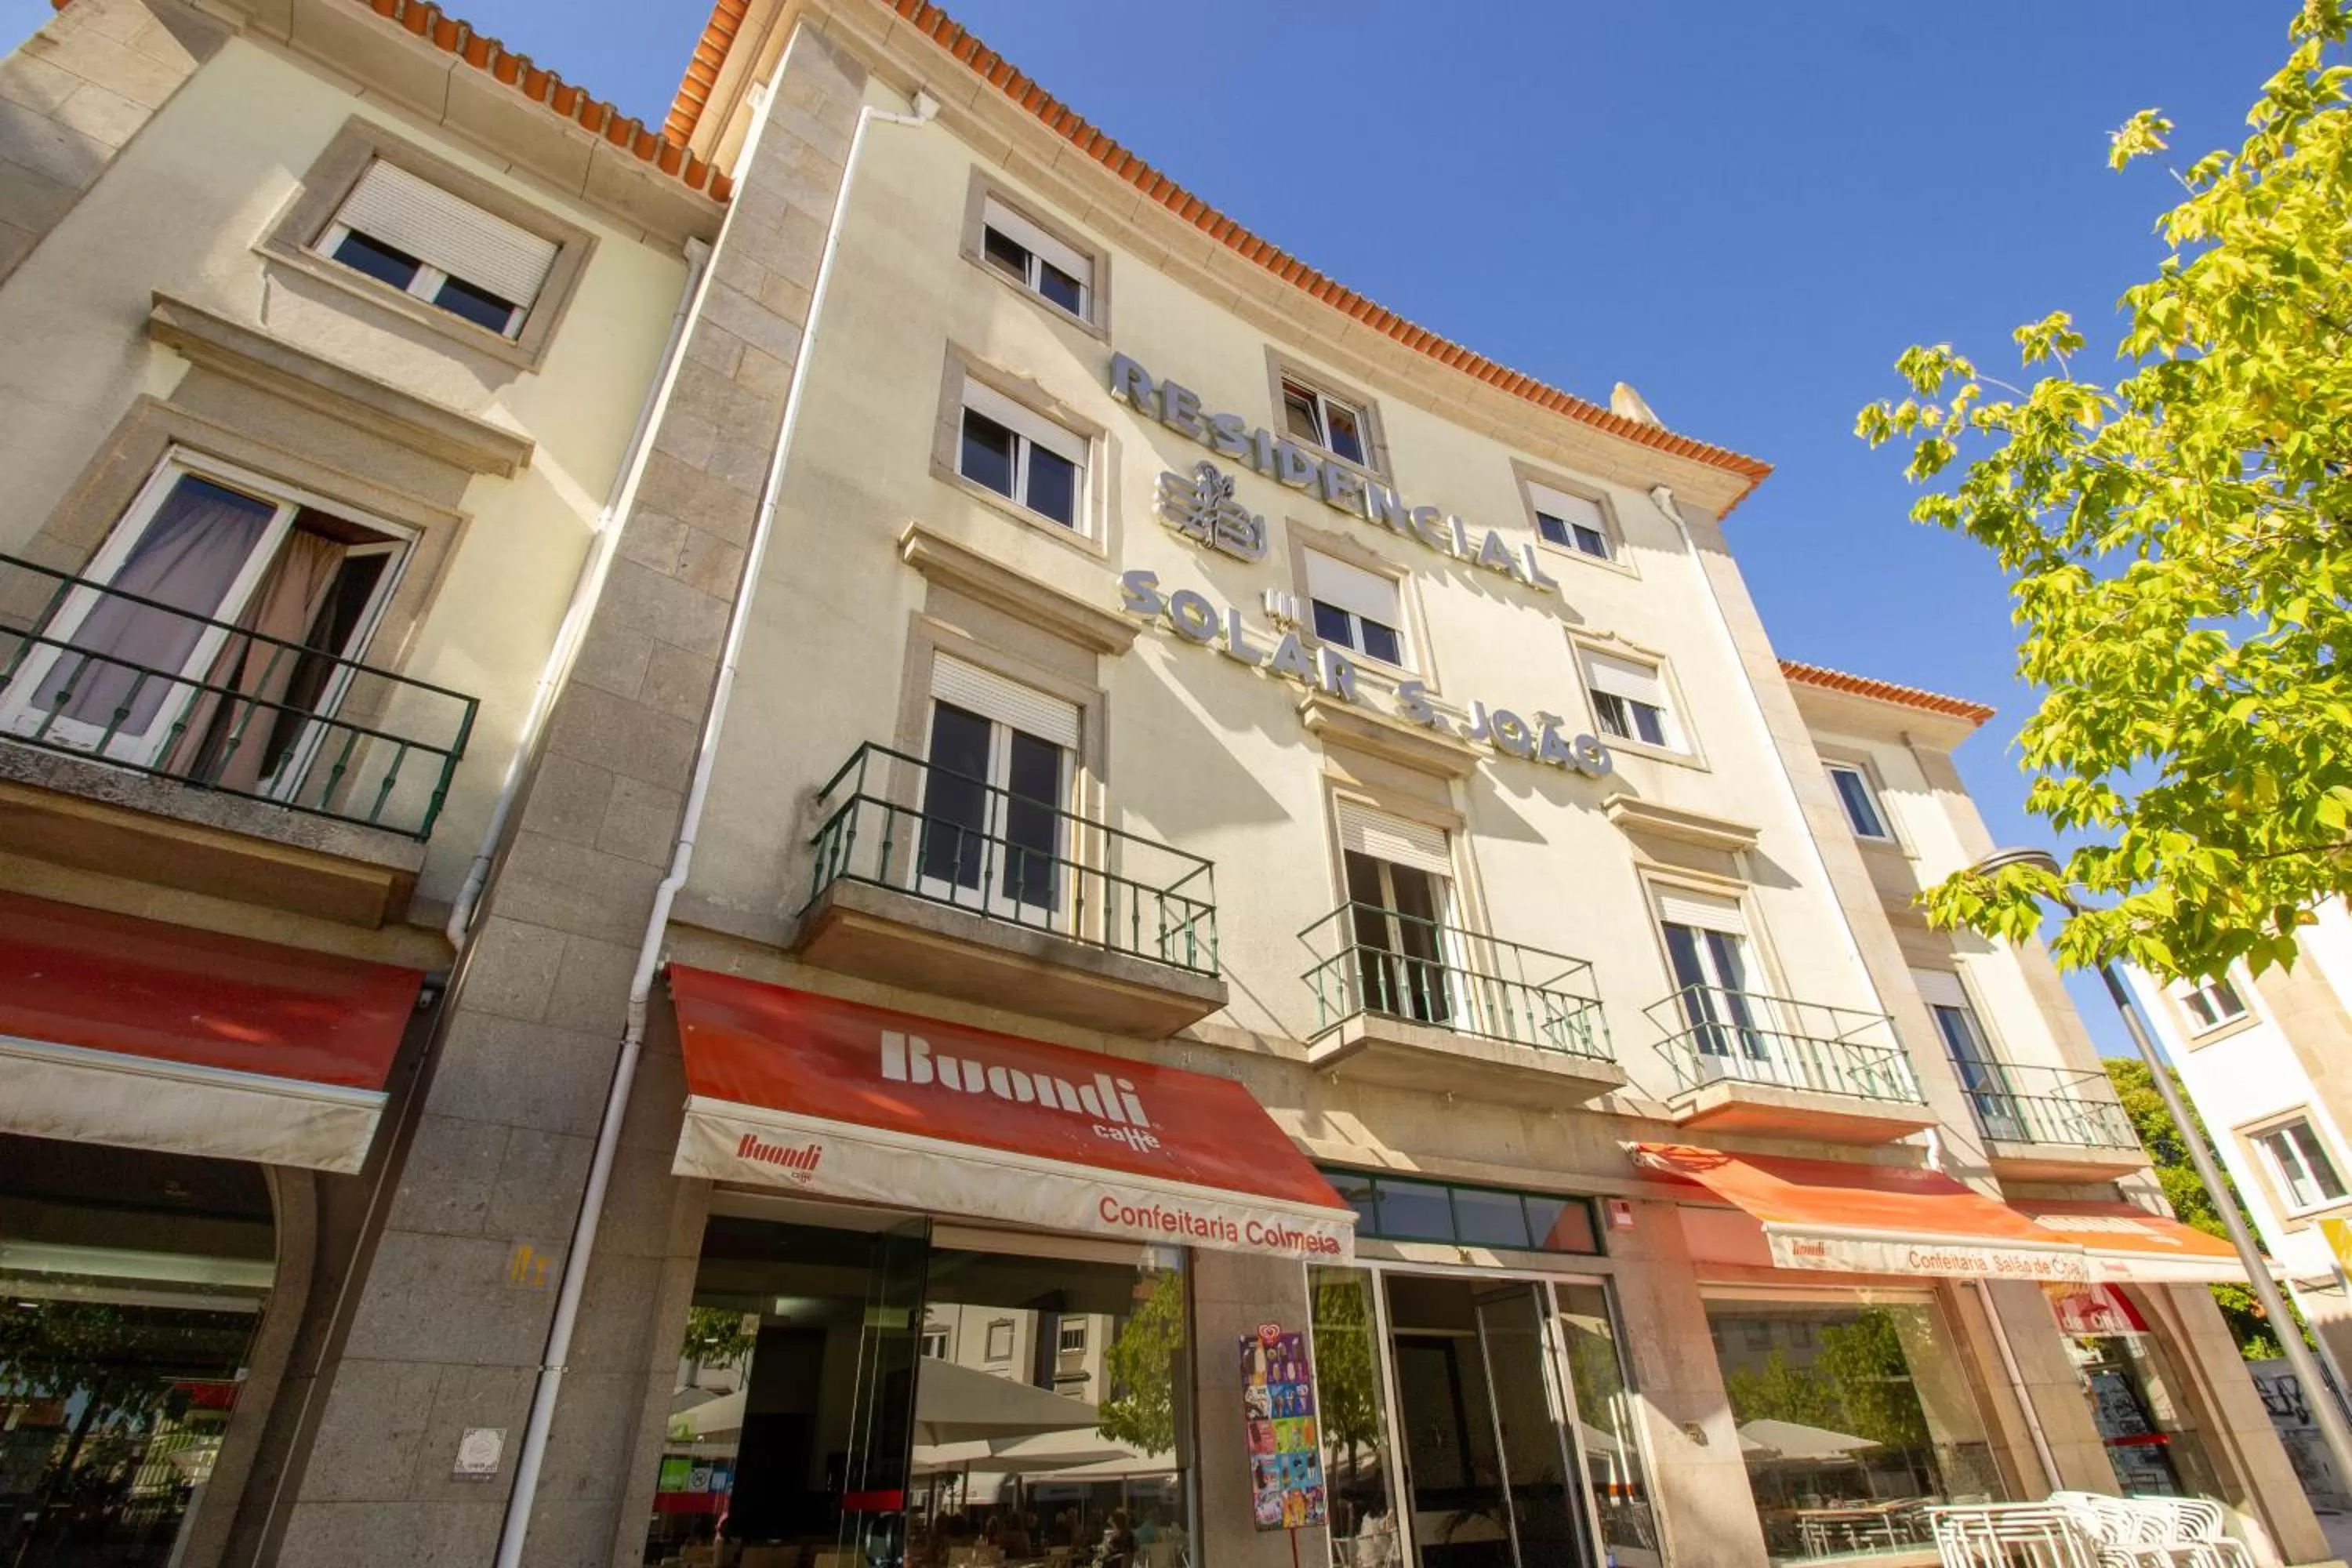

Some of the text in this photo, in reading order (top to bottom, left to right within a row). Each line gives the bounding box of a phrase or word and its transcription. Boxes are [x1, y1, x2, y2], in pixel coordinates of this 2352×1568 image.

[1109, 351, 1559, 592] RESIDENCIAL
[1118, 570, 1613, 779] SOLAR S. JOÃO
[881, 1029, 1150, 1127] Buondi
[737, 1133, 822, 1170] Buondi
[1099, 1196, 1341, 1254] Confeitaria Colmeia
[1909, 1250, 1988, 1270] Confeitaria
